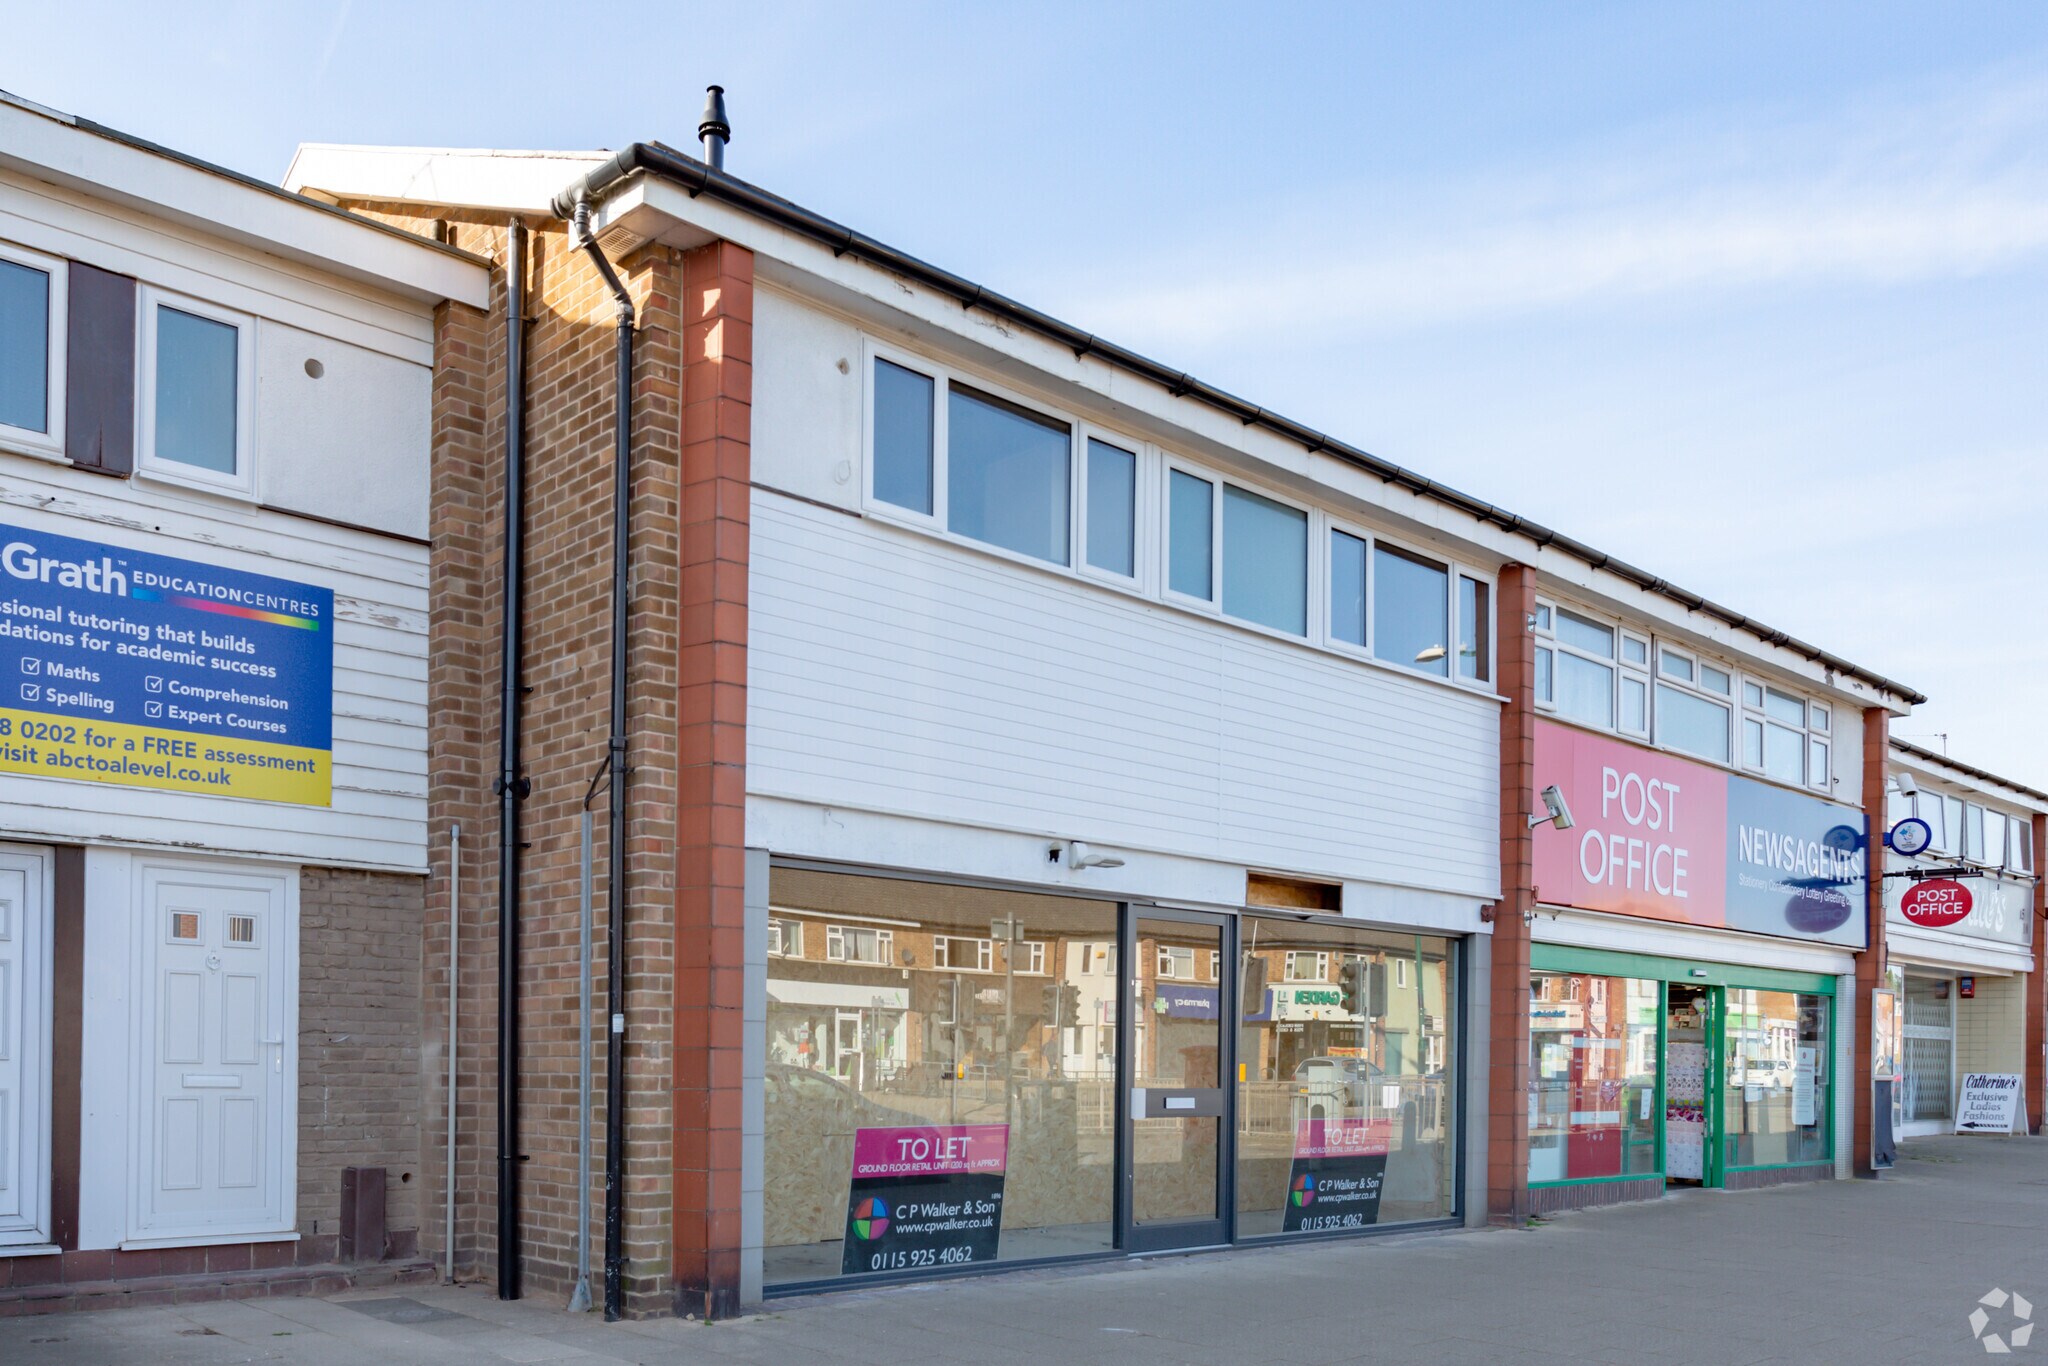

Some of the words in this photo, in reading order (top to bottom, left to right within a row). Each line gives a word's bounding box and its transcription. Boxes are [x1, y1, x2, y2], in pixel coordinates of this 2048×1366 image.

[0, 542, 127, 597] Grath
[0, 599, 62, 623] sional
[68, 610, 150, 641] tutoring
[156, 624, 196, 645] that
[201, 631, 256, 655] builds
[0, 619, 75, 647] dations
[80, 632, 111, 652] for
[116, 643, 206, 667] academic
[211, 656, 277, 678] success
[46, 661, 101, 683] Maths
[45, 688, 115, 714] Spelling
[168, 680, 289, 710] Comprehension
[168, 704, 222, 725] Expert
[226, 713, 288, 734] Courses
[20, 721, 77, 745] 0202
[83, 728, 117, 749] for
[123, 738, 135, 752] a
[143, 736, 197, 759] FREE
[204, 748, 316, 774] assessment
[0, 742, 38, 764] isit
[45, 748, 231, 785] abctoalevel.co.uk
[1602, 766, 1680, 833] POST
[1579, 828, 1689, 898] OFFICE
[1738, 824, 1861, 885] NEWSAGENTS
[1738, 873, 1768, 892] Stationery
[1768, 880, 1806, 899] Confectionery
[1805, 886, 1824, 903] Lottery
[1823, 889, 1846, 907] Greeting
[1917, 888, 1959, 903] POST
[1907, 902, 1964, 916] OFFICE
[1965, 1074, 2017, 1090] Catherine's
[1966, 1091, 2009, 1102] Exclusive
[1970, 1101, 2001, 1111] Ladies
[1963, 1110, 2006, 1121] Fashions
[1323, 1128, 1343, 1146] TO
[1345, 1127, 1370, 1145] LET
[897, 1138, 929, 1161] TO
[934, 1136, 972, 1159] LET
[858, 1163, 888, 1174] GROUND
[889, 1162, 911, 1173] FLOOR
[911, 1161, 933, 1171] RETAIL
[933, 1160, 950, 1170] UNIT
[976, 1158, 1001, 1167] APPROX
[1318, 1180, 1326, 1192] C
[1327, 1179, 1333, 1191] P
[1333, 1178, 1359, 1191] Walker
[1359, 1177, 1366, 1189] &
[1366, 1177, 1380, 1189] Son
[1317, 1190, 1377, 1204] www.cpwalker.co.uk
[896, 1205, 907, 1220] C
[909, 1204, 918, 1219] P
[920, 1202, 961, 1218] Walker
[963, 1200, 972, 1215] &
[975, 1199, 996, 1214] Son
[895, 1215, 993, 1235] www.cpwalker.co.uk
[1301, 1217, 1323, 1231] 0115
[1325, 1215, 1341, 1229] 925
[1342, 1213, 1363, 1226] 4062
[871, 1251, 906, 1270] 0115
[910, 1248, 936, 1267] 925
[939, 1245, 973, 1264] 4062
